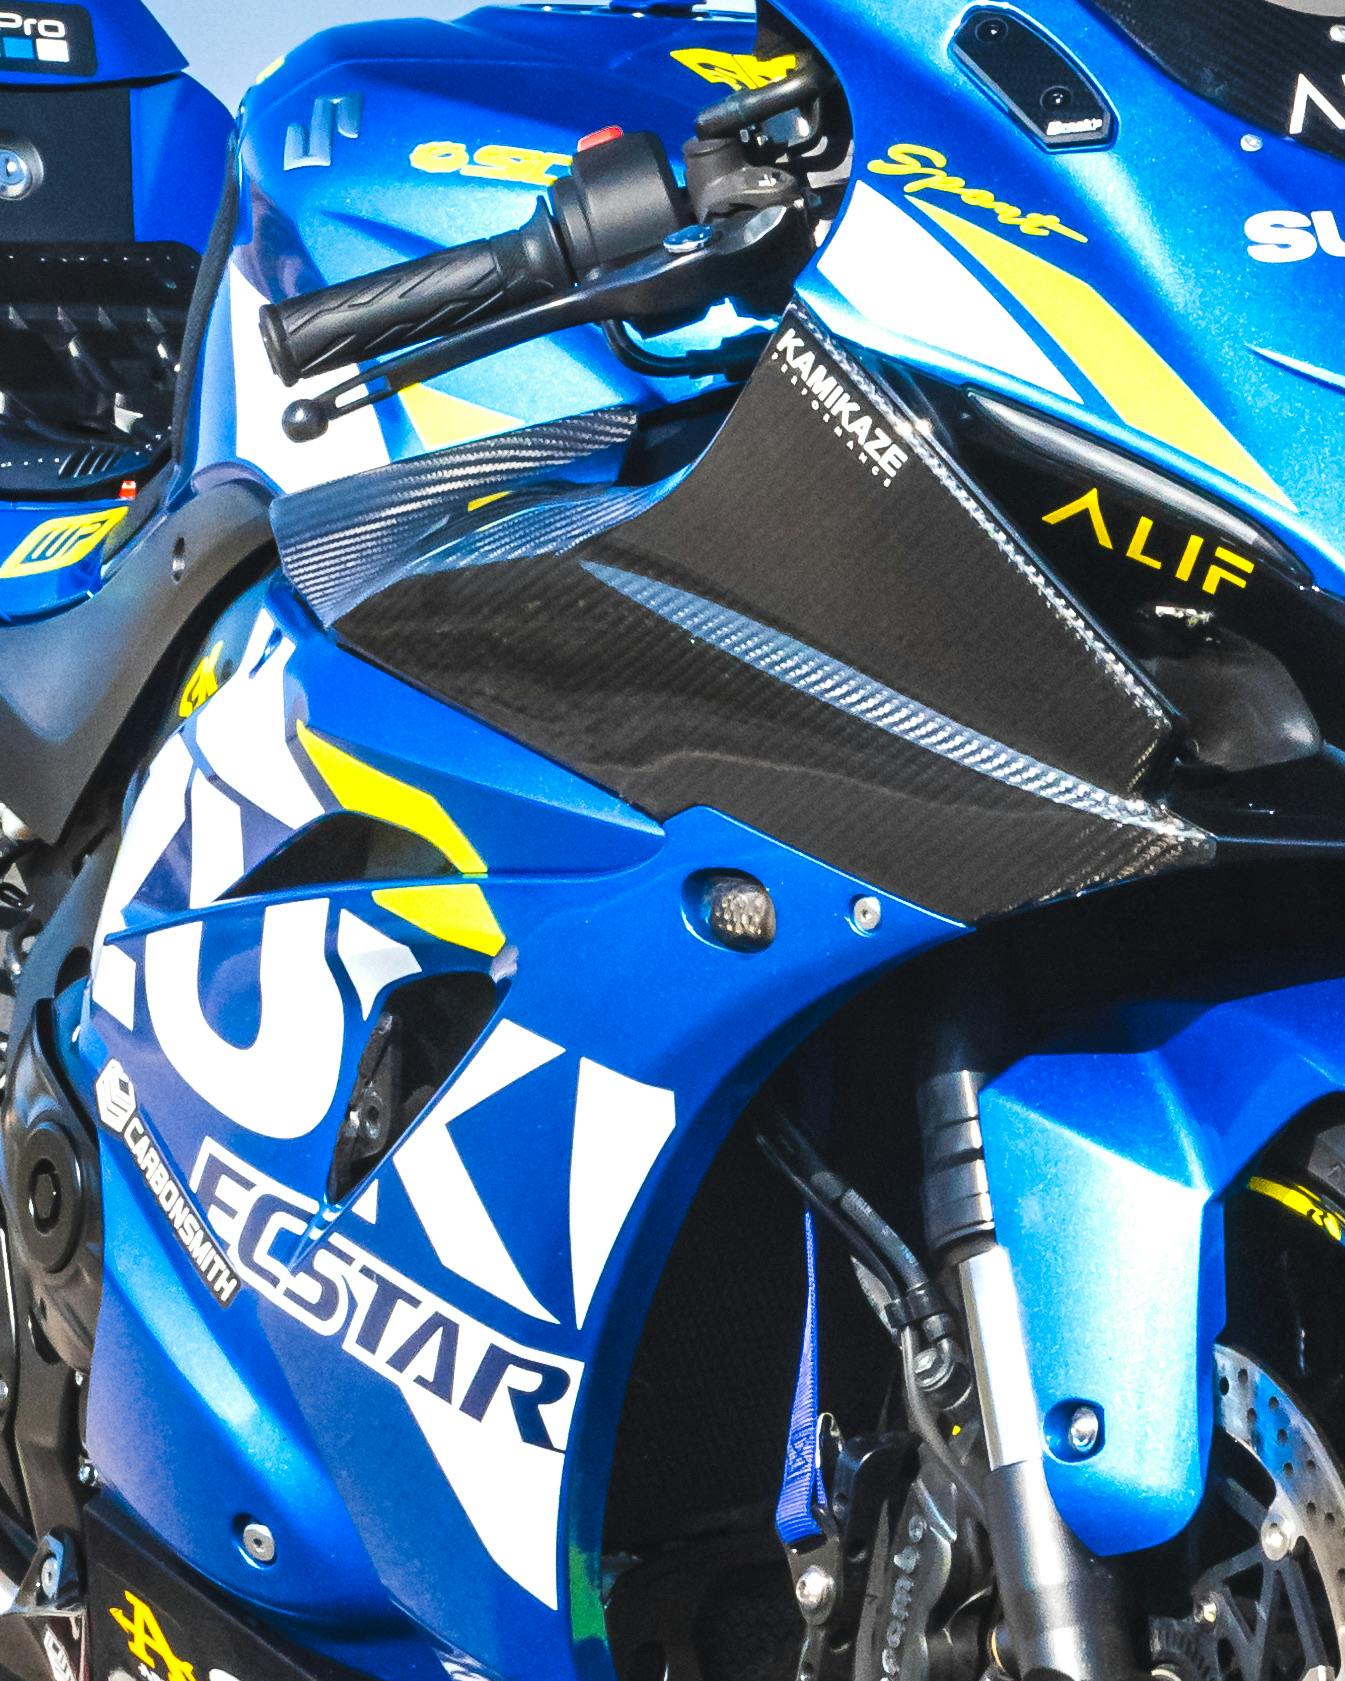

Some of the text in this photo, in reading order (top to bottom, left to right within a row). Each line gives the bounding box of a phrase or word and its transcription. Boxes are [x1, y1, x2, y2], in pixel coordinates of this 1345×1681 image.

[776, 327, 909, 478] KAMIKAZE
[1041, 487, 1255, 595] ALIF
[123, 1116, 239, 1303] CARBONSMITH
[192, 1148, 572, 1454] ECSTAR
